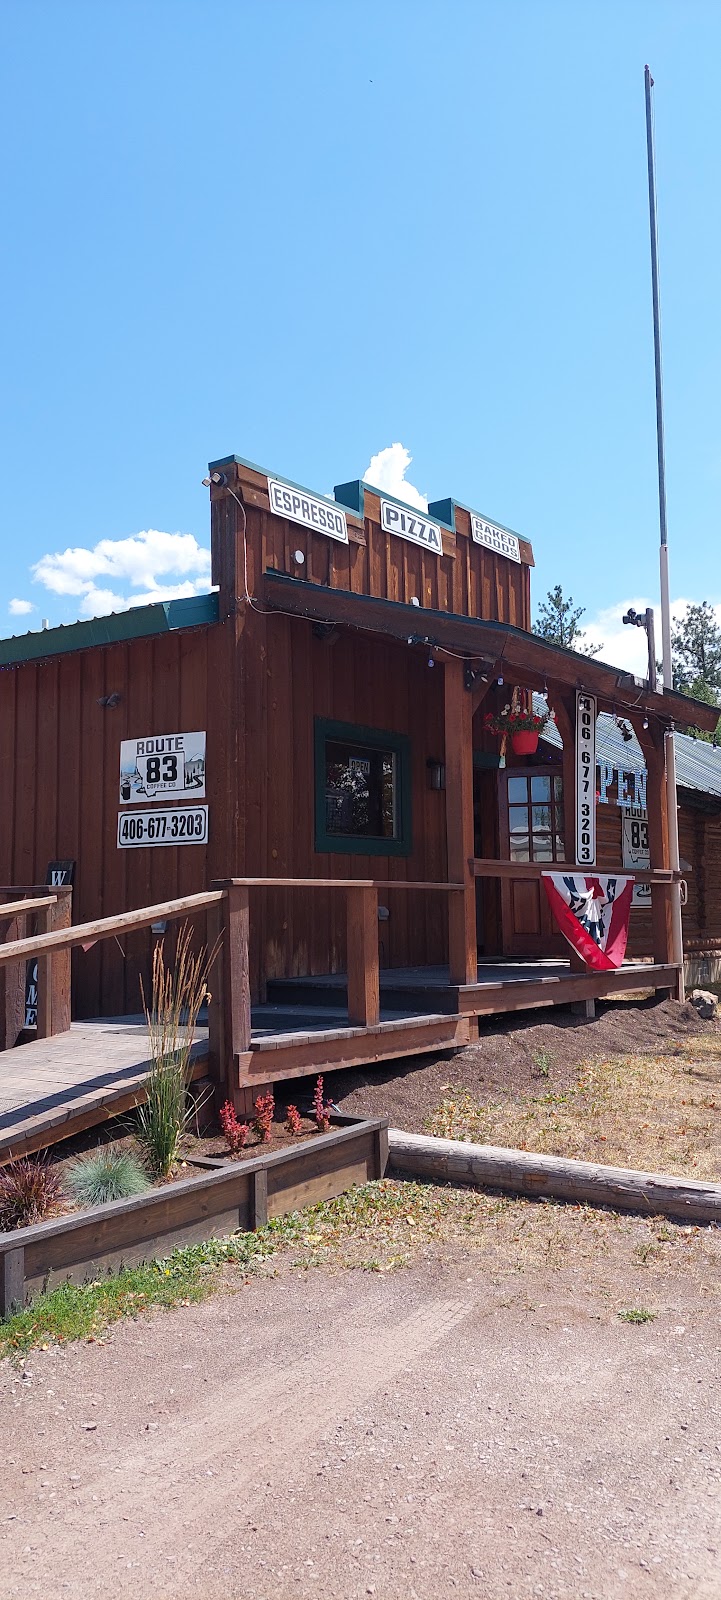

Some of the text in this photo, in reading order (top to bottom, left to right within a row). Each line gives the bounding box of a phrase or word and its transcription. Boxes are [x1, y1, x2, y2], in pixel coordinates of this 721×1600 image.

[273, 487, 344, 535] ESPRESSO
[386, 507, 439, 547] PIZZA
[475, 520, 516, 547] BAKED
[475, 530, 518, 558] GOODS
[136, 736, 184, 755] ROUTE
[146, 755, 178, 783] 83
[351, 760, 369, 774] OPEN
[599, 761, 647, 810] PEN
[625, 806, 648, 819] ROUT
[121, 814, 203, 840] 406-677-3203
[631, 821, 649, 849] 83
